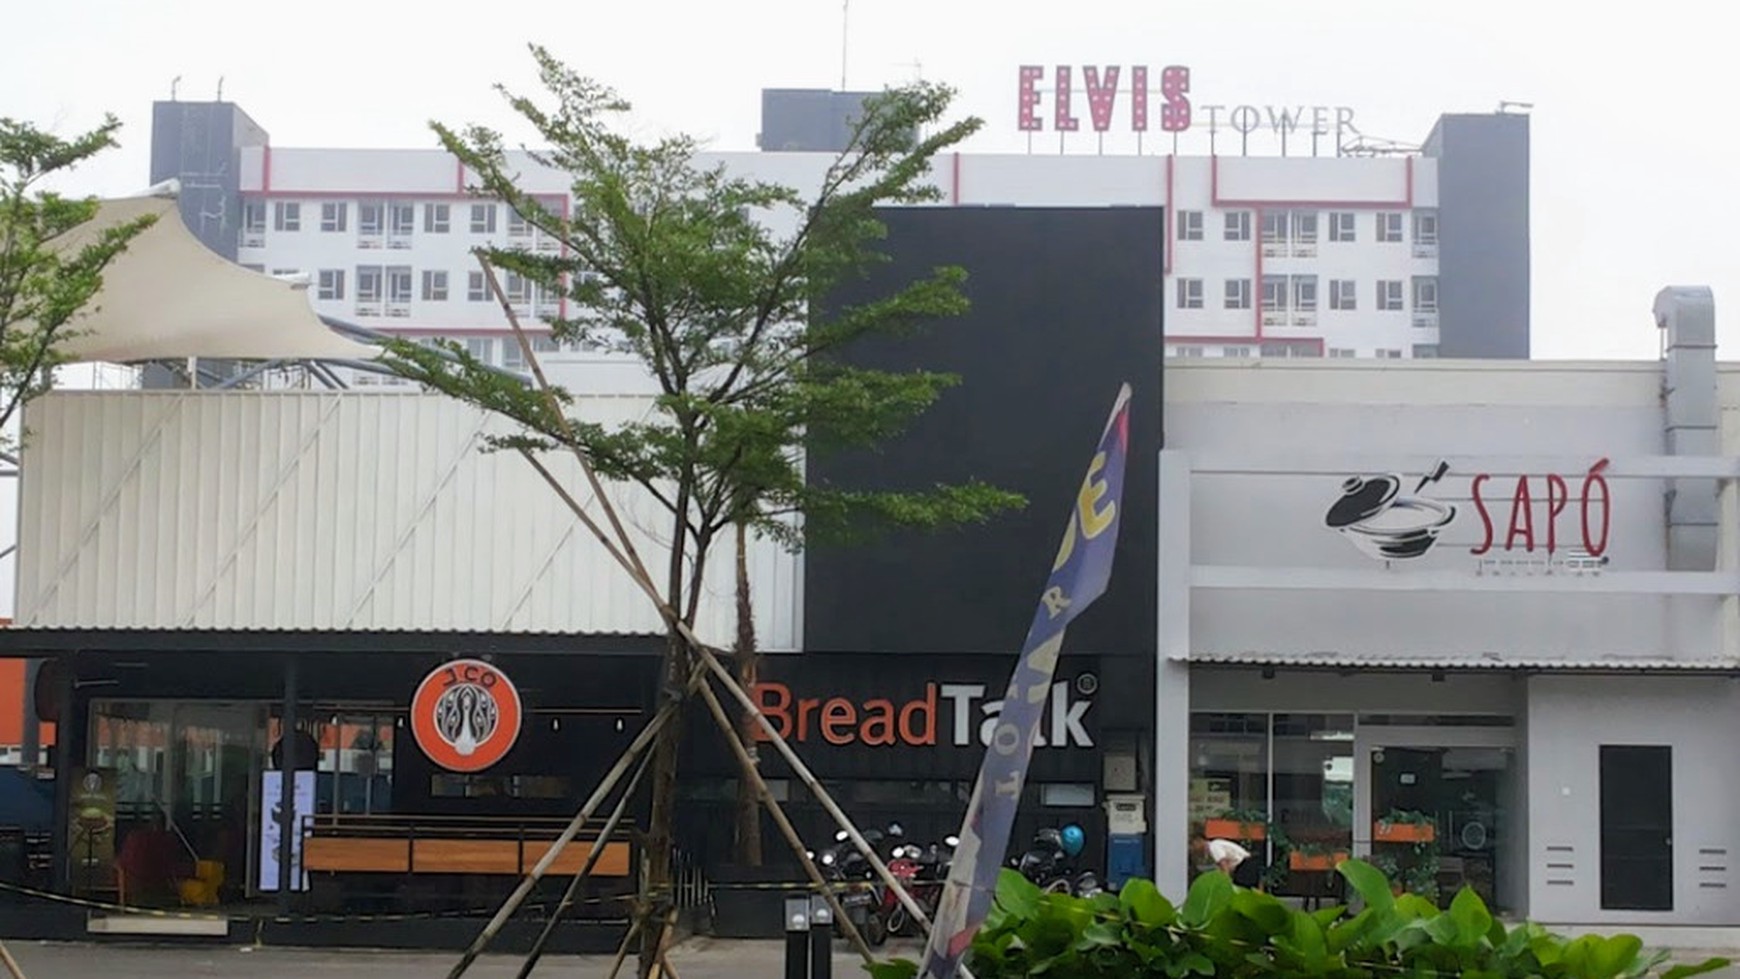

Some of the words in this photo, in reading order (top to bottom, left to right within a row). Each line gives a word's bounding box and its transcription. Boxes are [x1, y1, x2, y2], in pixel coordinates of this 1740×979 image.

[1018, 65, 1192, 132] ELVIS
[1200, 105, 1361, 135] TOWER
[1470, 458, 1610, 557] SAPÓ
[752, 681, 1095, 747] BreadTk
